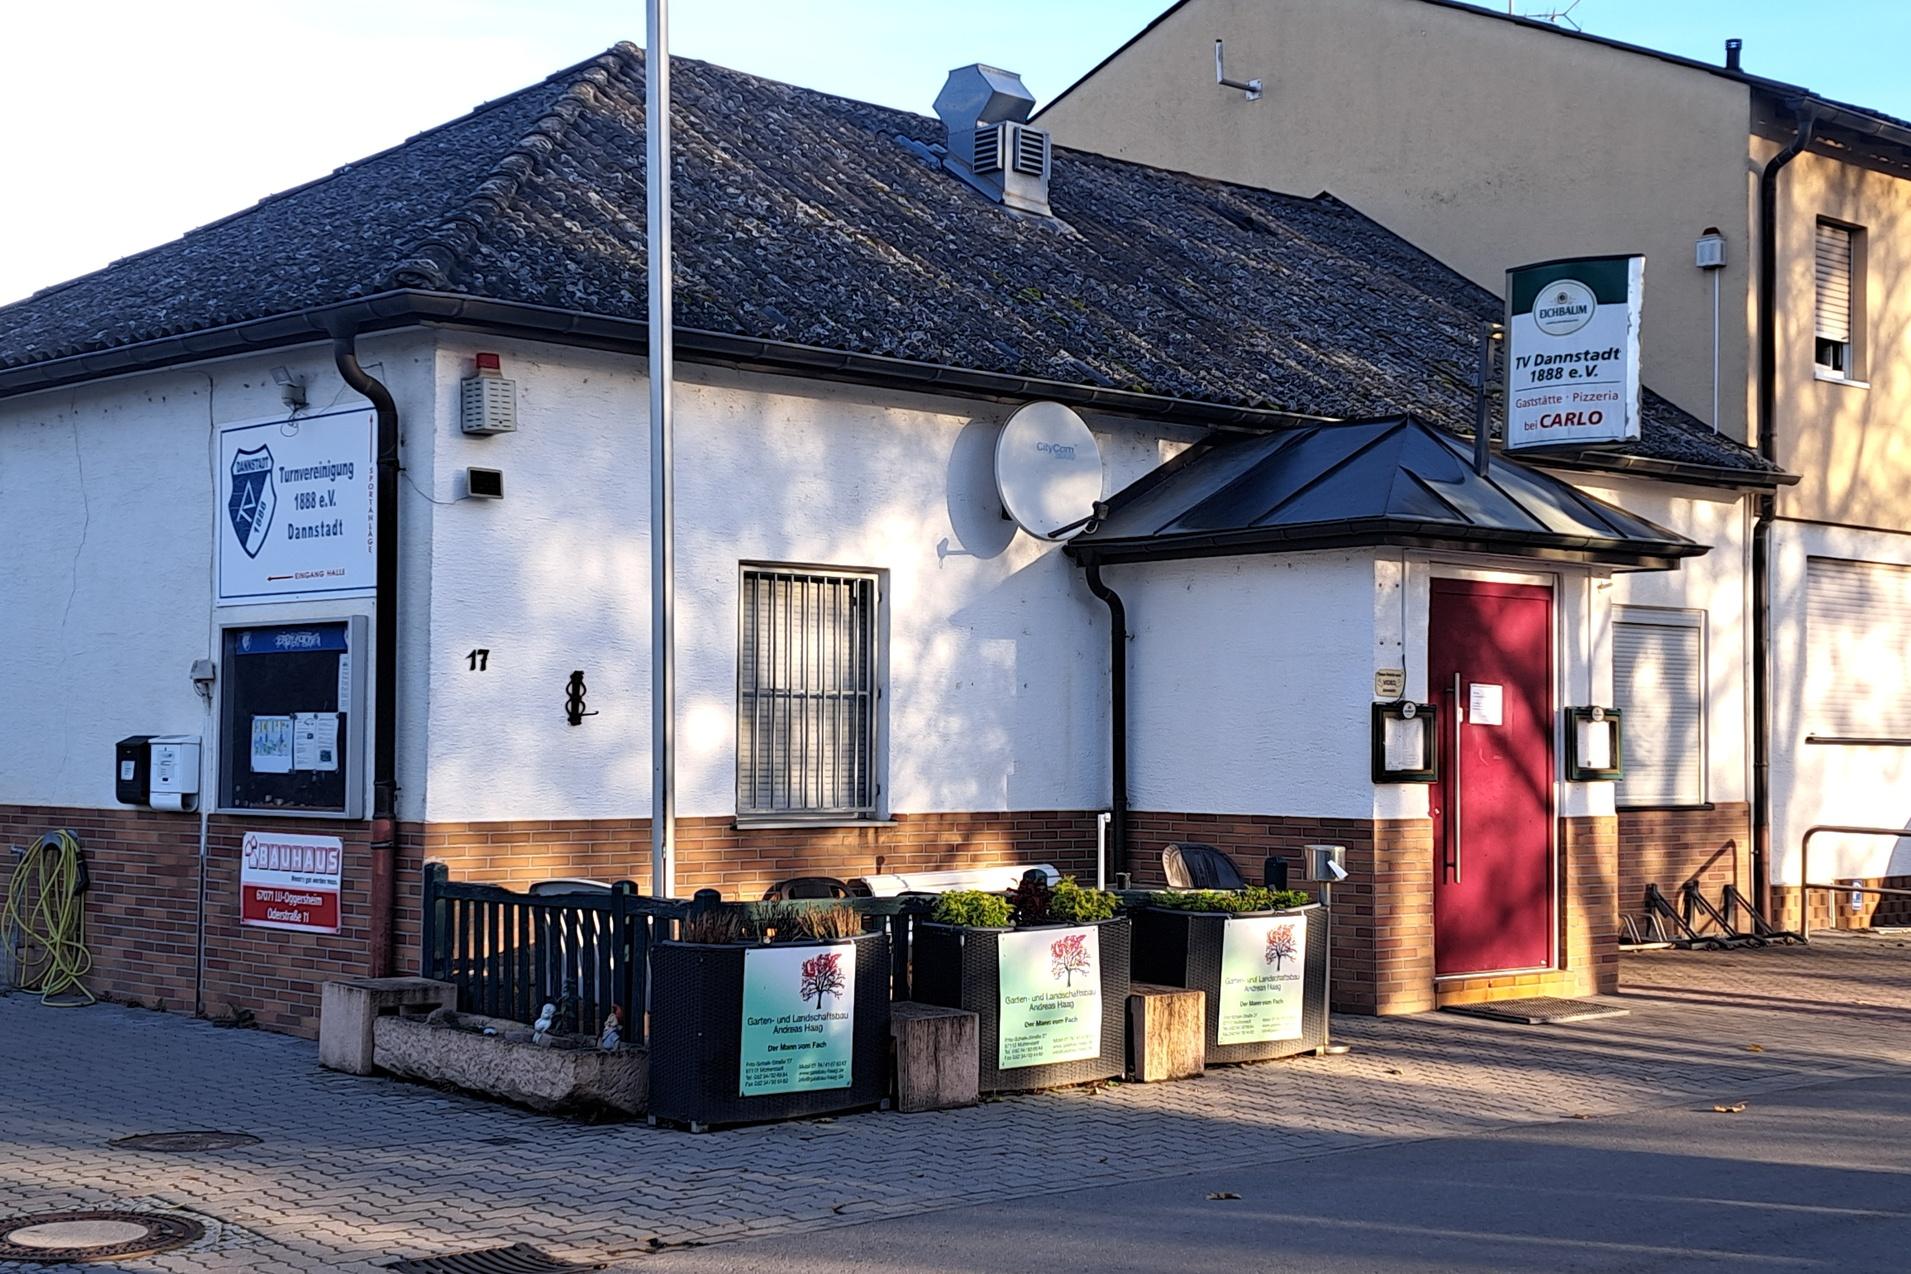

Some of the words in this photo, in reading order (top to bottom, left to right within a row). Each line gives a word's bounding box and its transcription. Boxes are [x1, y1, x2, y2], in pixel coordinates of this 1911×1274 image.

[1540, 305, 1588, 319] EICHBAUM
[1516, 354, 1532, 370] TV
[1534, 347, 1622, 367] Dannstadt
[1530, 367, 1564, 383] 1888
[1568, 364, 1599, 378] e.V.
[1516, 394, 1562, 408] Gaststätte
[1572, 390, 1619, 402] Pizzeria
[1524, 420, 1538, 431] bei
[1540, 410, 1603, 428] CARLO
[236, 456, 269, 472] DANNSTADT
[279, 460, 354, 484] Turnvereinigung
[294, 491, 316, 510] 1888
[319, 489, 336, 507] e.V.
[288, 518, 343, 540] Dannstadt
[295, 570, 324, 580] EINGANG
[327, 568, 345, 576] HALLE
[465, 649, 490, 671] 17
[259, 844, 340, 874] BAUHAUS
[1046, 989, 1096, 1000] Landschaftsbau
[1029, 1003, 1056, 1011] Andreas
[748, 1017, 774, 1026] Garten-
[777, 1015, 791, 1024] und
[792, 1012, 849, 1023] Landschaftsbau
[772, 1025, 802, 1034] Andreas
[804, 1024, 823, 1033] Haag
